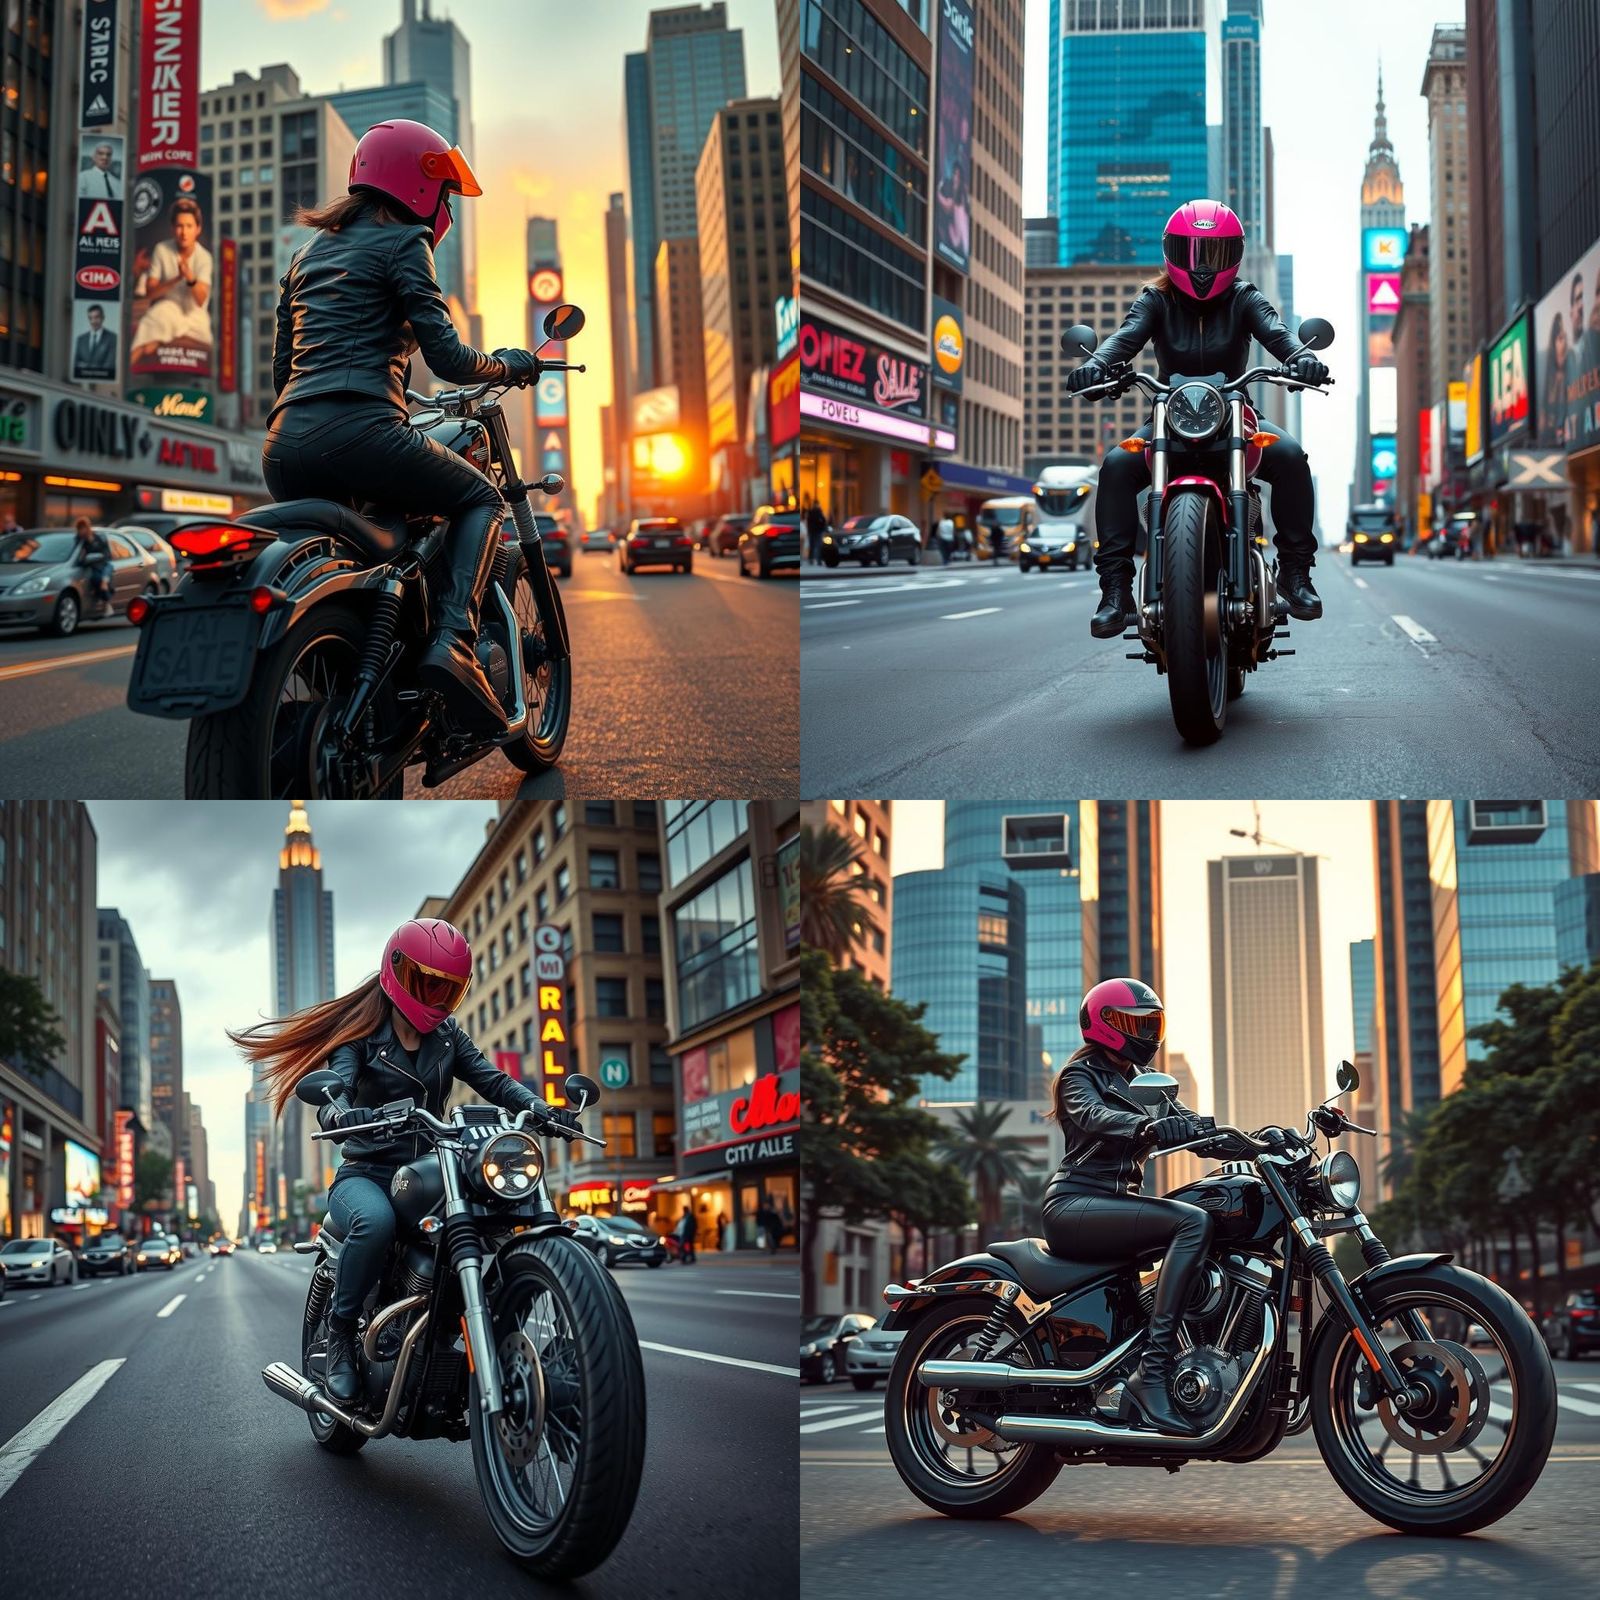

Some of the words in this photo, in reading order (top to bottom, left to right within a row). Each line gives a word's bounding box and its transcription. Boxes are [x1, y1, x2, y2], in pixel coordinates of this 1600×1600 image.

[873, 350, 921, 408] SALE
[539, 986, 567, 1107] RALL
[606, 1064, 622, 1082] N
[724, 1143, 757, 1165] CITY
[757, 1135, 794, 1159] ALLE
